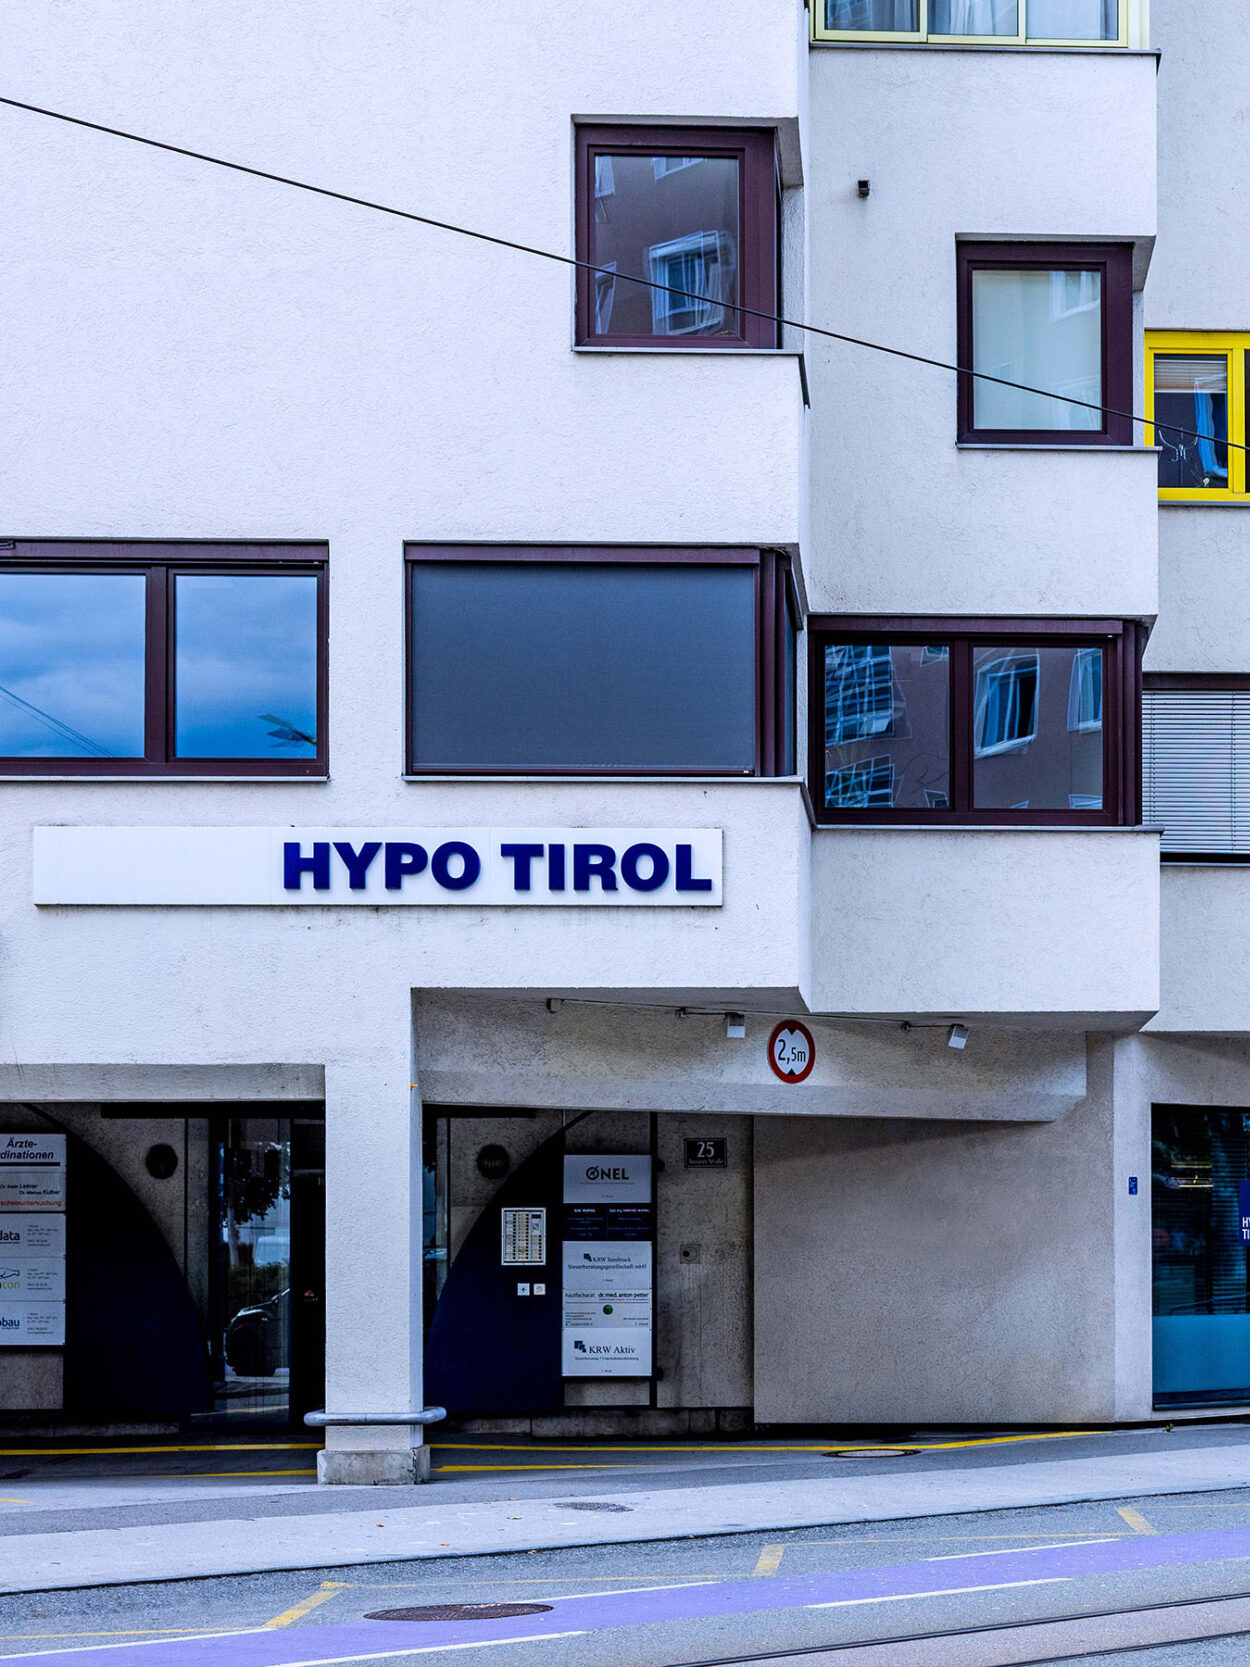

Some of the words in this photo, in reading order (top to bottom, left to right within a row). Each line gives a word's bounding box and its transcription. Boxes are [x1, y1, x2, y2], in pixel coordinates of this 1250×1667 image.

[283, 840, 481, 891] HYPO
[500, 842, 713, 892] TIROL
[777, 1038, 806, 1065] 2,5m
[6, 1136, 38, 1149] Ärzte-
[696, 1141, 715, 1158] 25
[0, 1317, 20, 1327] bau
[588, 1345, 611, 1354] KRW
[613, 1345, 636, 1354] Aktiv
